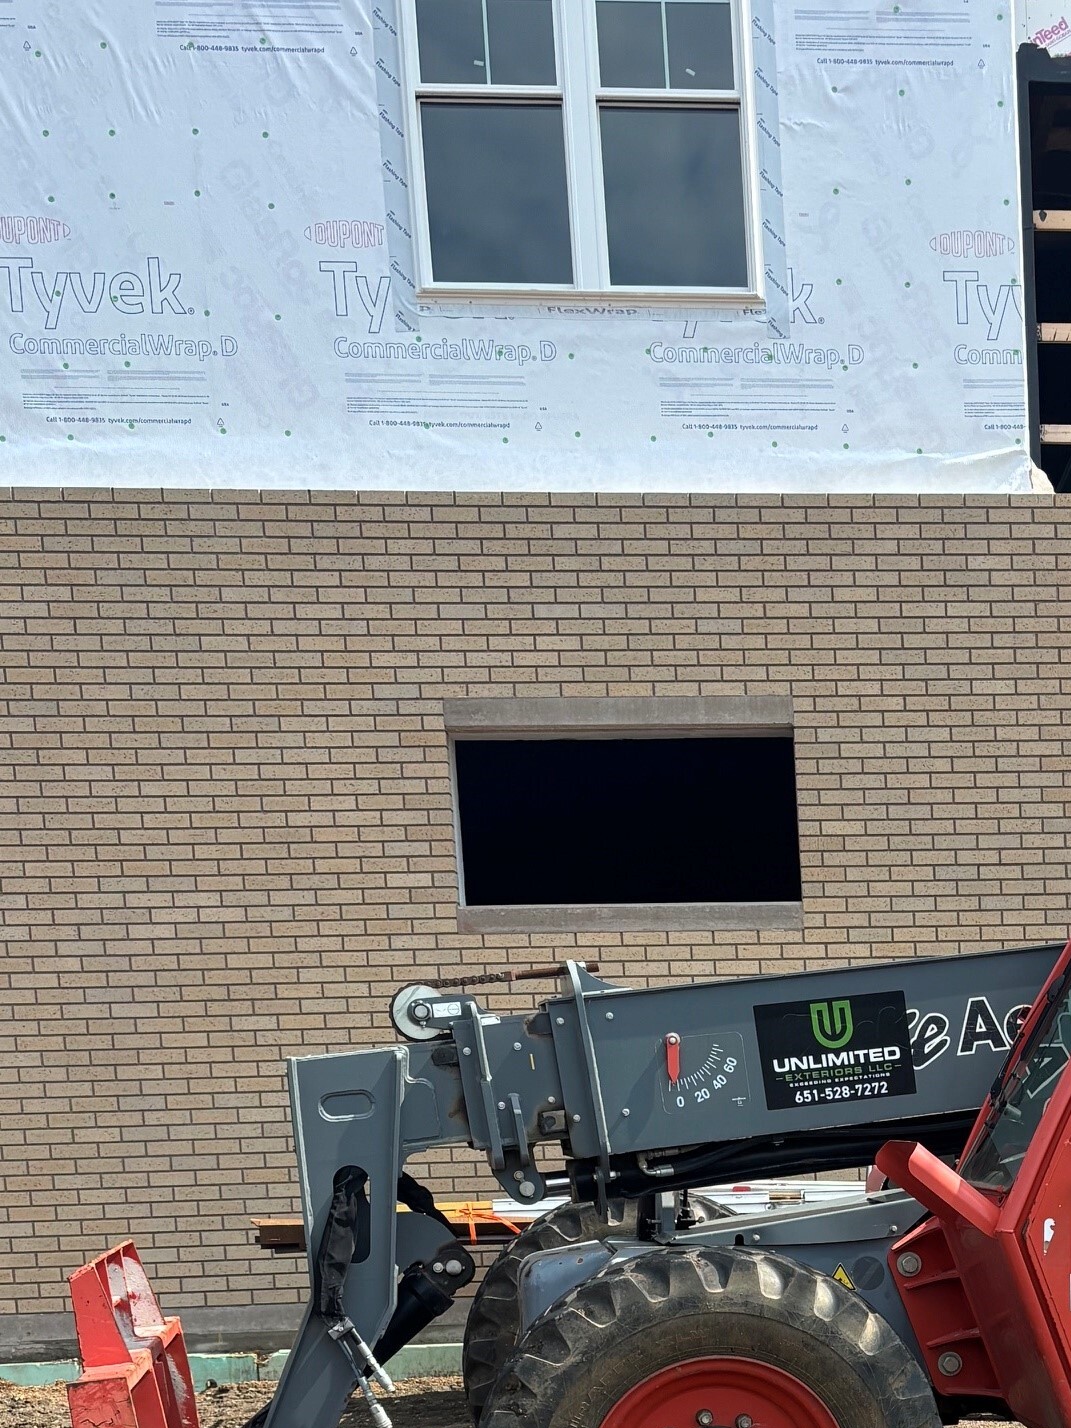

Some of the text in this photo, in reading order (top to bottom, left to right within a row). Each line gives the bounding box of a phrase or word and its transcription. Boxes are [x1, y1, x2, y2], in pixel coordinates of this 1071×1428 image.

[373, 9, 397, 36] Flashing Tape
[752, 19, 776, 45] Flashing Tape
[376, 60, 401, 87] Flashing Tape
[875, 59, 954, 67] tyvek.com/commercialwrapd
[754, 70, 779, 96] Flashing Tape
[379, 112, 404, 138] Flashing Tape
[757, 120, 781, 147] Flashing Tape
[382, 162, 408, 188] Flashing Tape
[759, 171, 783, 197] Flashing Tape
[0, 216, 61, 244] UPONT
[314, 219, 385, 248] DUPONT
[386, 213, 412, 239] Flashing Tape
[762, 221, 786, 247] Flashing Tape
[939, 229, 1006, 258] DUPONT
[390, 263, 416, 289] Flashing Tape
[765, 271, 789, 296] Flashing Tape
[547, 306, 638, 316] FlexWrap
[219, 335, 239, 357] D
[539, 340, 558, 362] D
[847, 344, 865, 365] D
[108, 417, 192, 425] tyvek.com/commercialwrapd
[428, 421, 511, 429] tyvek.com/commercialwrapd
[724, 1056, 738, 1074] 60
[772, 1045, 901, 1073] UNLIMITED
[712, 1074, 728, 1091] 40
[784, 1062, 893, 1082] EXTERIORS LLC
[789, 1072, 891, 1088] EXCEEDING EXPECTATIONS
[676, 1096, 685, 1108] 0
[694, 1088, 711, 1104] 20
[794, 1081, 889, 1104] 651-528-7272
